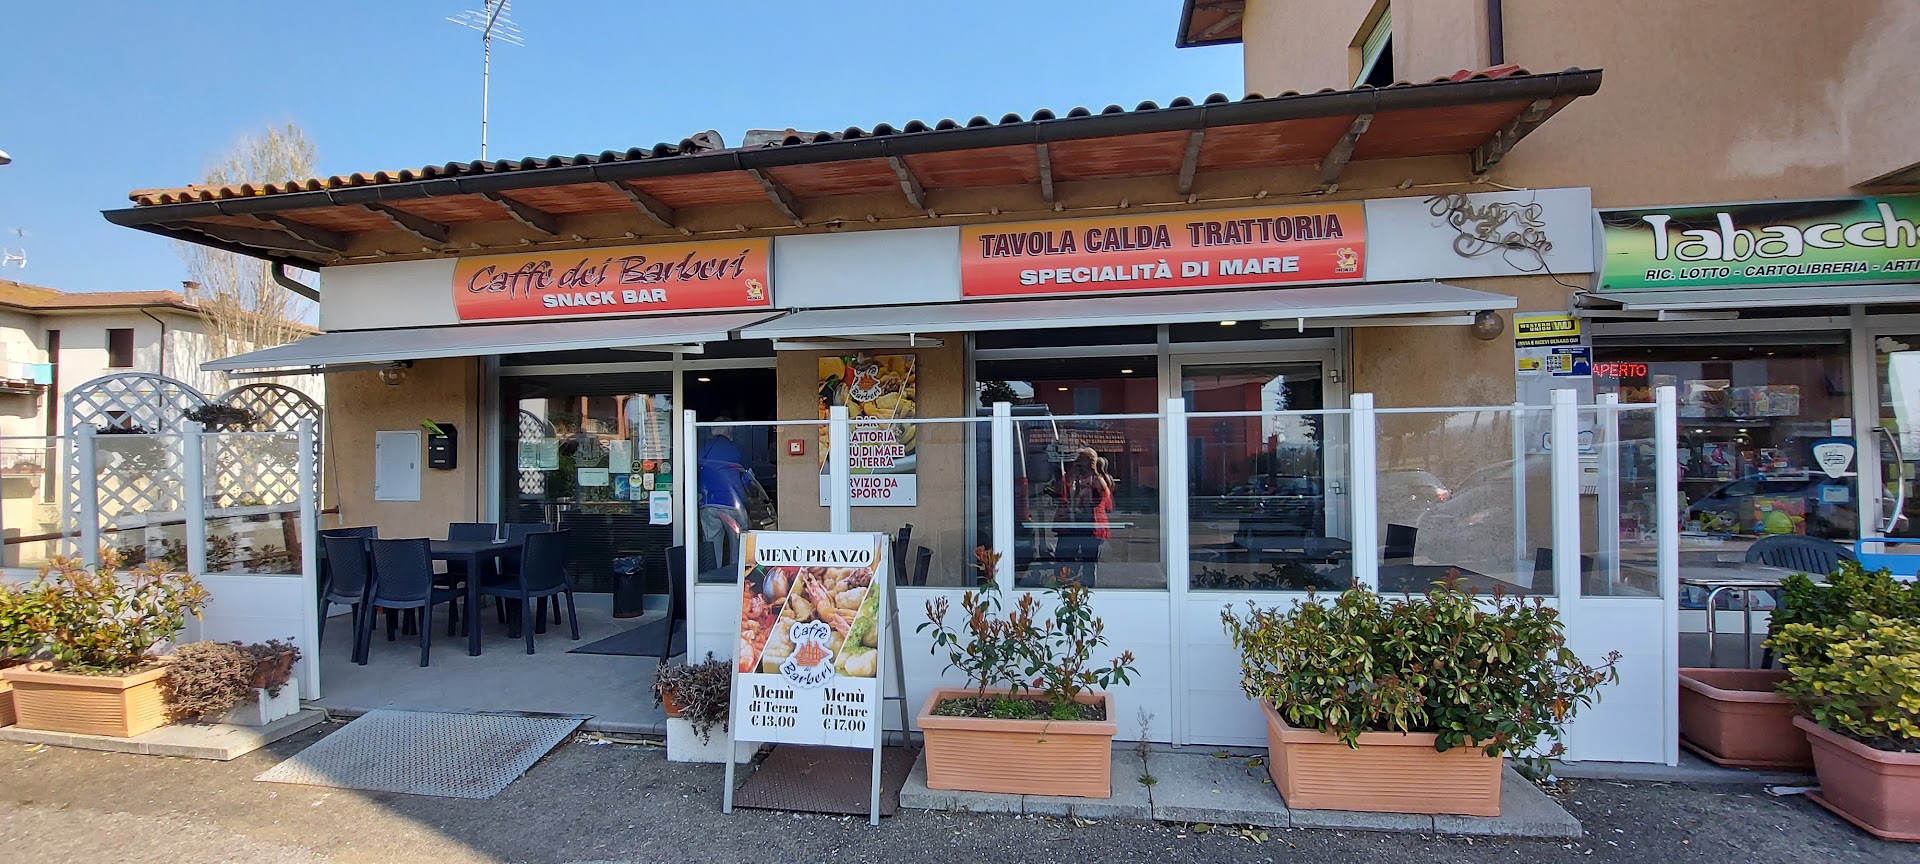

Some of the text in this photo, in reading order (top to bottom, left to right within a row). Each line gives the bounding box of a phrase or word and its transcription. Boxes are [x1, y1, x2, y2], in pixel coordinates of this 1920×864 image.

[979, 213, 1344, 258] TAVOLA CALDA TRATTORIA
[1641, 202, 1920, 262] Tabacch
[468, 248, 750, 300] Caffè dei Barberi
[1020, 256, 1300, 286] SPECIALITÀ DI MARE
[1645, 269, 1675, 280] RIC.
[1680, 267, 1730, 279] LOTTO
[1745, 262, 1867, 276] CARTOLIBRERIA
[542, 288, 667, 308] SNACK BAR
[1592, 363, 1647, 378] APERTO
[857, 416, 877, 427] BAR
[849, 431, 895, 441] ATTORIA
[862, 446, 872, 456] DI
[875, 446, 904, 456] MARE
[862, 457, 894, 467] TERRA
[849, 478, 898, 488] RVIZIO DA
[851, 489, 891, 499] SPORTO
[758, 546, 870, 563] MENÙ PRANZO
[793, 623, 828, 639] Caffè
[783, 661, 832, 685] Barberi
[752, 684, 794, 699] Menù
[823, 687, 865, 703] Menù
[748, 700, 798, 714] di Terra
[821, 703, 868, 717] di Mare
[751, 714, 759, 726] €
[823, 718, 866, 733] € 17,00
